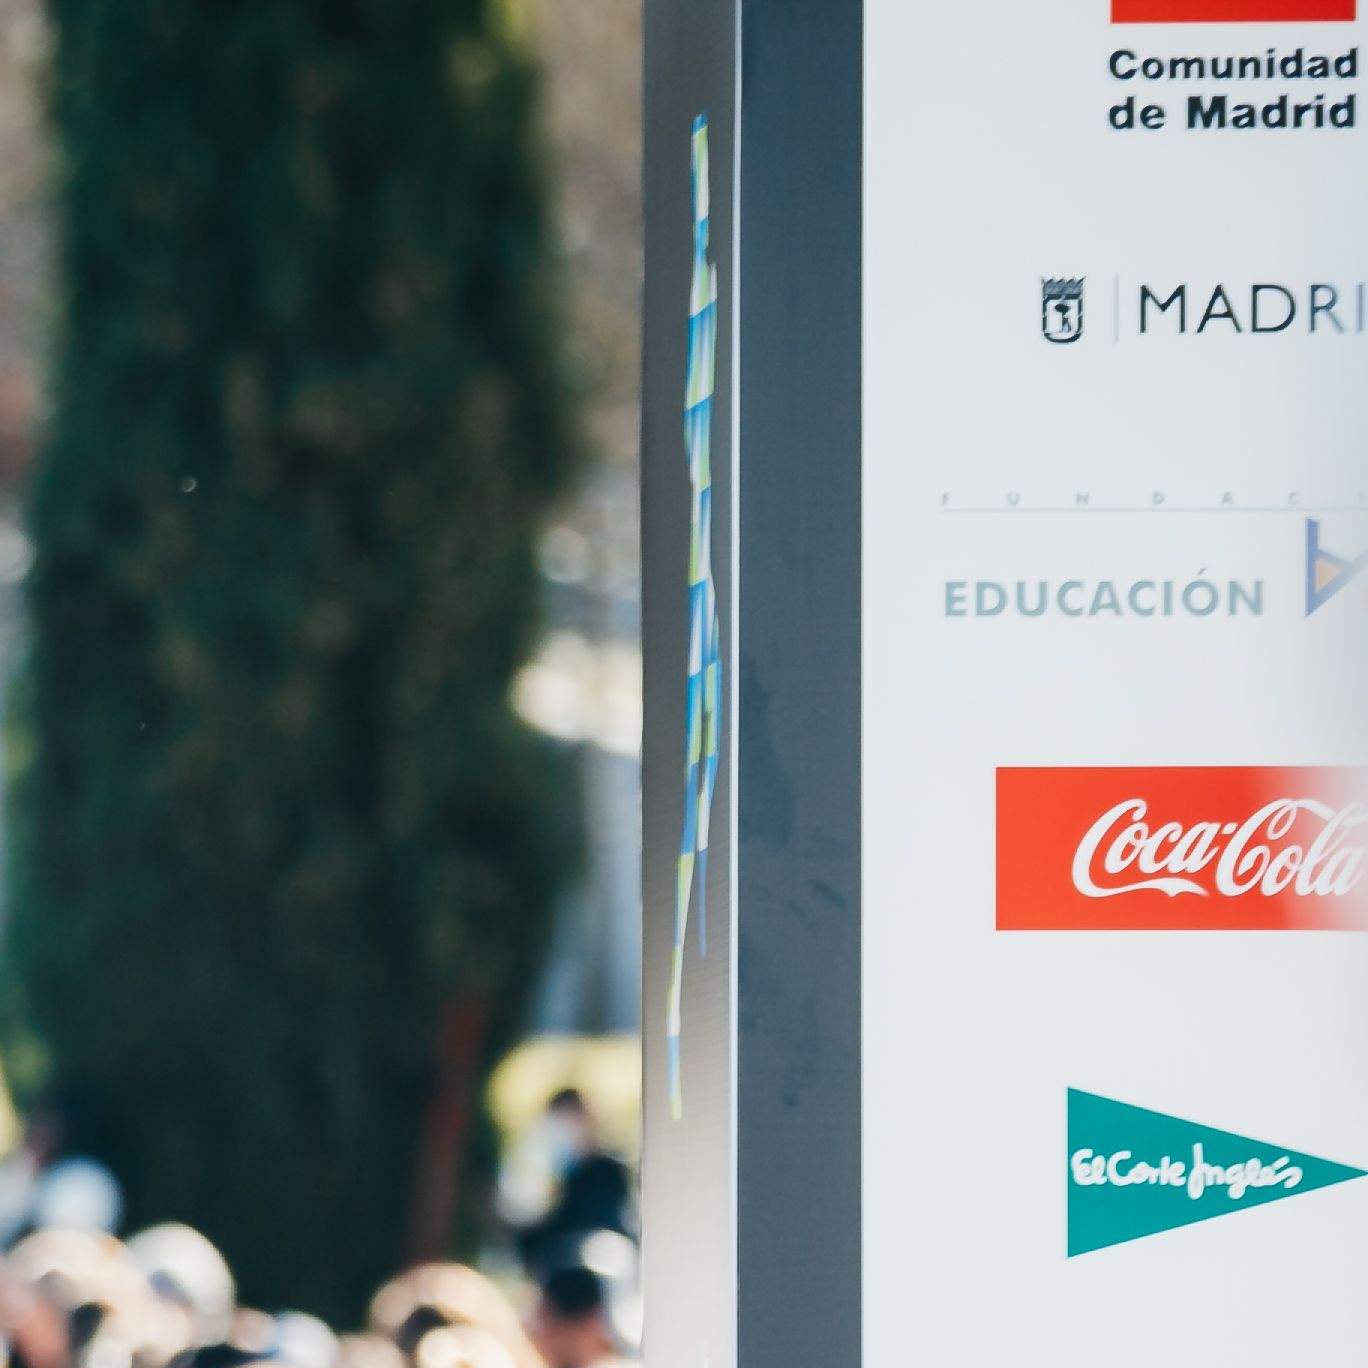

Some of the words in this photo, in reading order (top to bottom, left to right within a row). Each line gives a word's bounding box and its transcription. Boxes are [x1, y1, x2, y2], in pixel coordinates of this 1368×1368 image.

[1108, 47, 1359, 80] Comunidad
[1108, 96, 1166, 129] de
[1186, 94, 1357, 129] Madrid
[944, 567, 1264, 617] EDUCACIÓN
[1072, 798, 1368, 897] Coca-Cola
[1071, 1148, 1108, 1186] El
[1107, 1150, 1186, 1187] Corte
